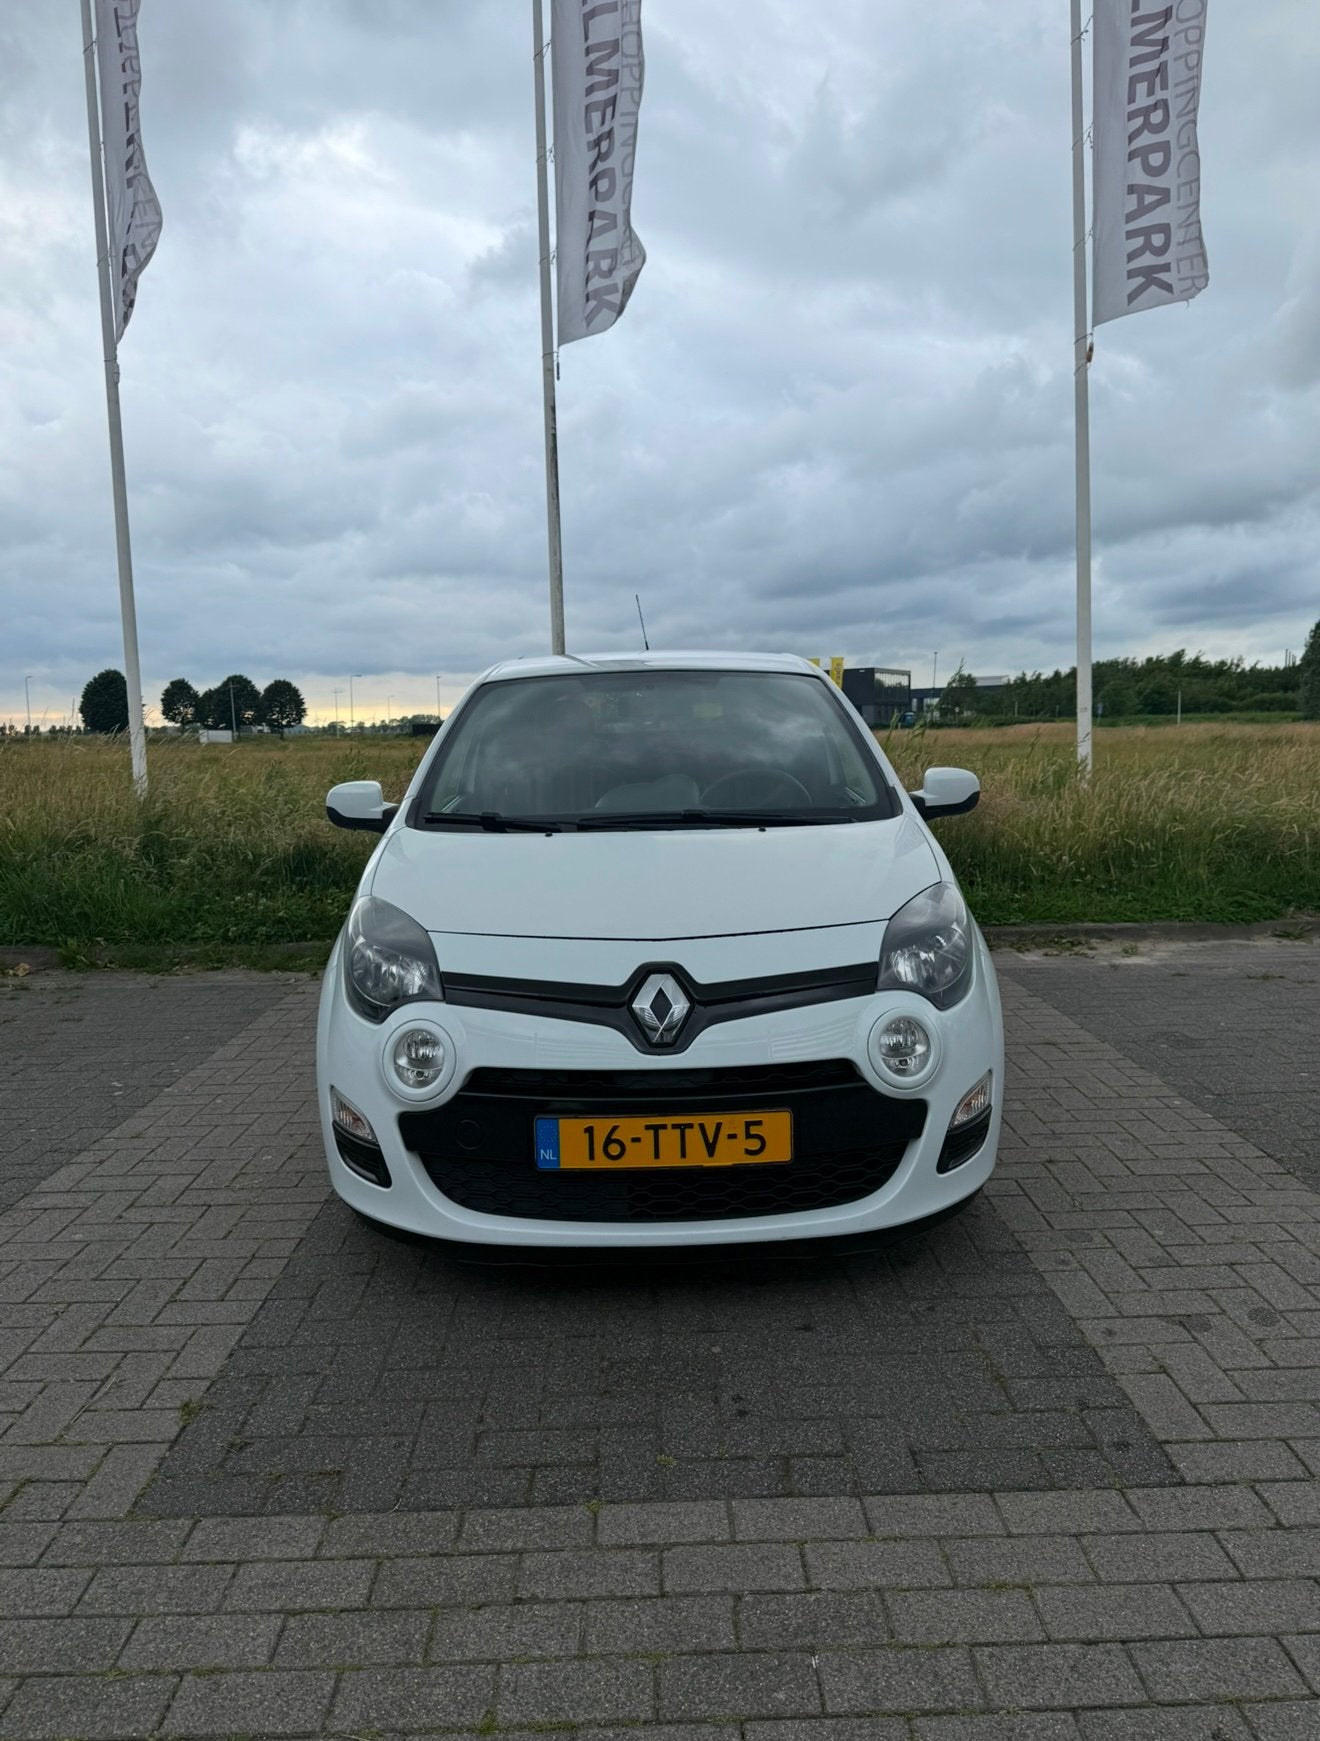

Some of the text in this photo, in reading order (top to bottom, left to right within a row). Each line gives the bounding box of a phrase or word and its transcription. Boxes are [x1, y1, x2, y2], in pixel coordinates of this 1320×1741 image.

[582, 0, 621, 330] LMERPARK
[540, 1149, 557, 1161] NL
[583, 1119, 767, 1162] 16-TTV-5
